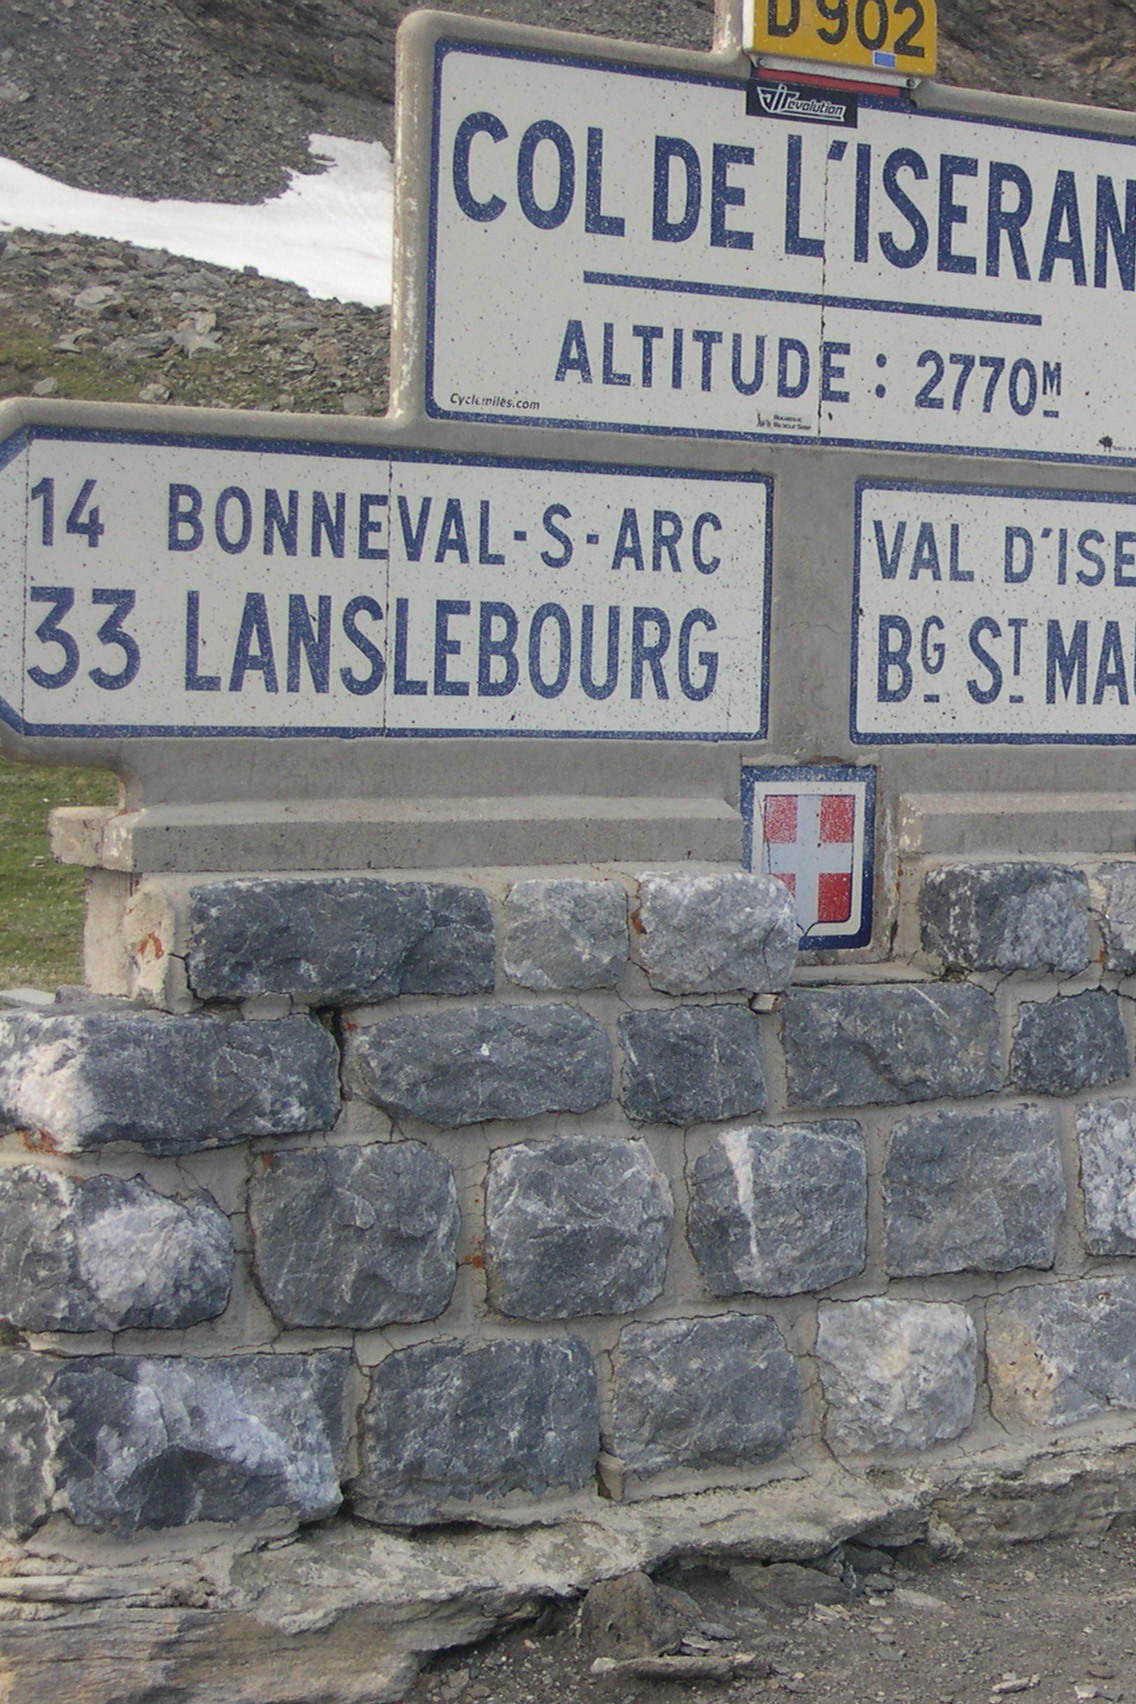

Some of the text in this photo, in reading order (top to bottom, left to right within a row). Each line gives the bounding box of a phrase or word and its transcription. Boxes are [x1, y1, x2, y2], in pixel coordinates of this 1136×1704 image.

[815, 0, 926, 58] 902
[453, 111, 626, 237] COL
[652, 136, 755, 250] DE
[556, 319, 851, 404] ALTITUDE
[914, 349, 1063, 418] 2770M
[30, 477, 723, 575] 14 BONNEVAL-S-ARC
[872, 519, 975, 583] VAL
[27, 586, 720, 703] 33 LANSLEBOURG
